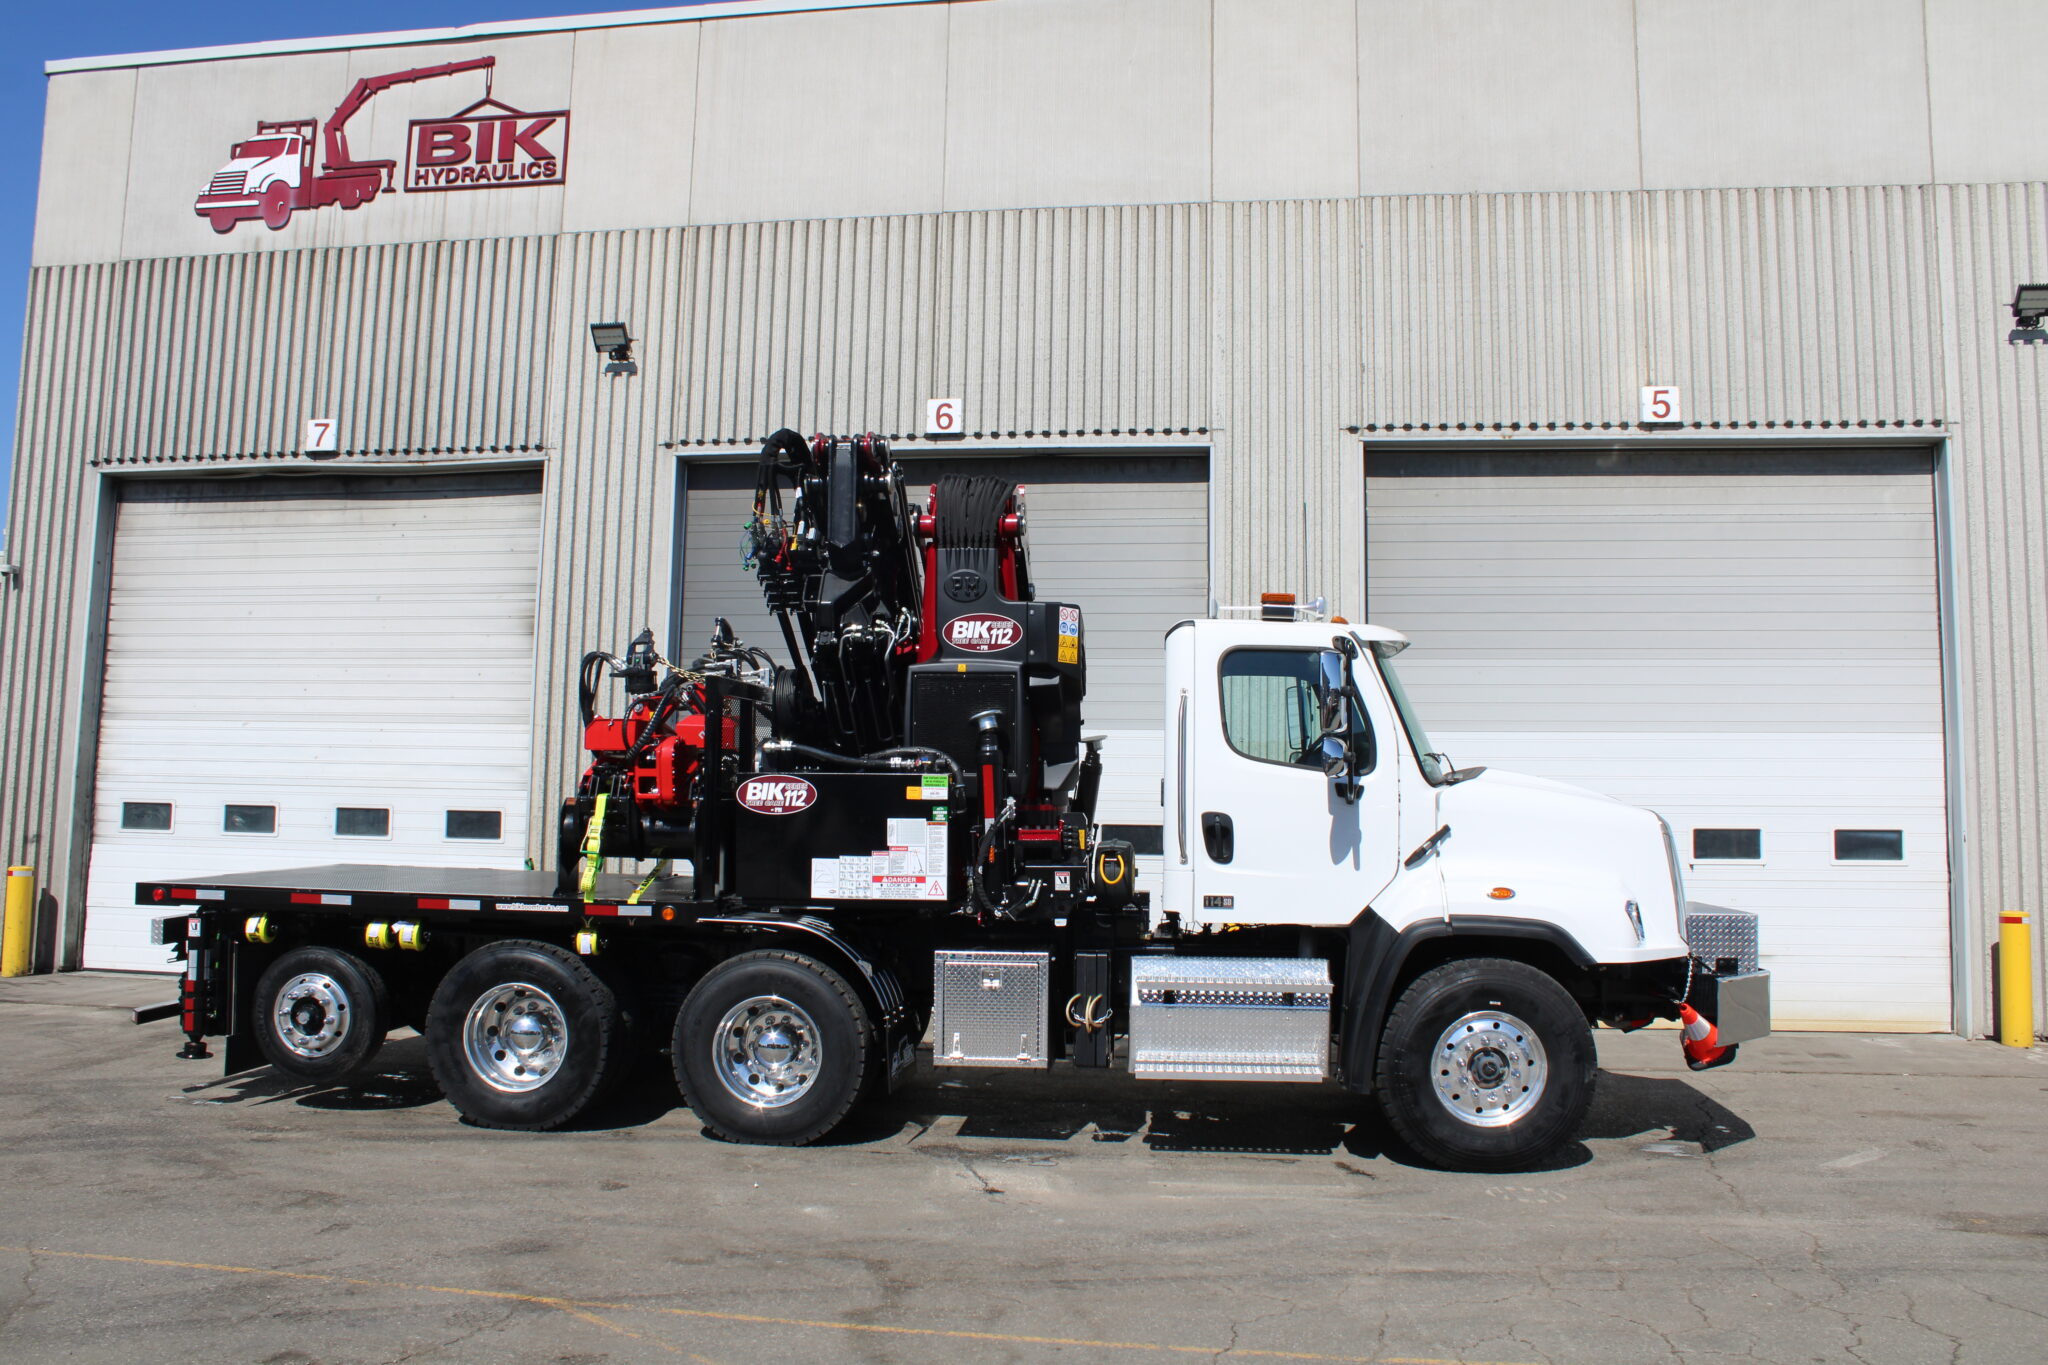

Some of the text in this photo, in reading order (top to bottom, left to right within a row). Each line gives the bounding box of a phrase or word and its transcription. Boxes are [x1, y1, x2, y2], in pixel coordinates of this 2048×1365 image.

[416, 118, 557, 167] BIK
[415, 161, 557, 186] HYDRAULICS
[936, 403, 953, 430] 6
[1652, 390, 1671, 419] 5
[314, 422, 330, 447] 7
[952, 621, 1013, 644] BIK 112
[746, 782, 807, 806] BIK 112
